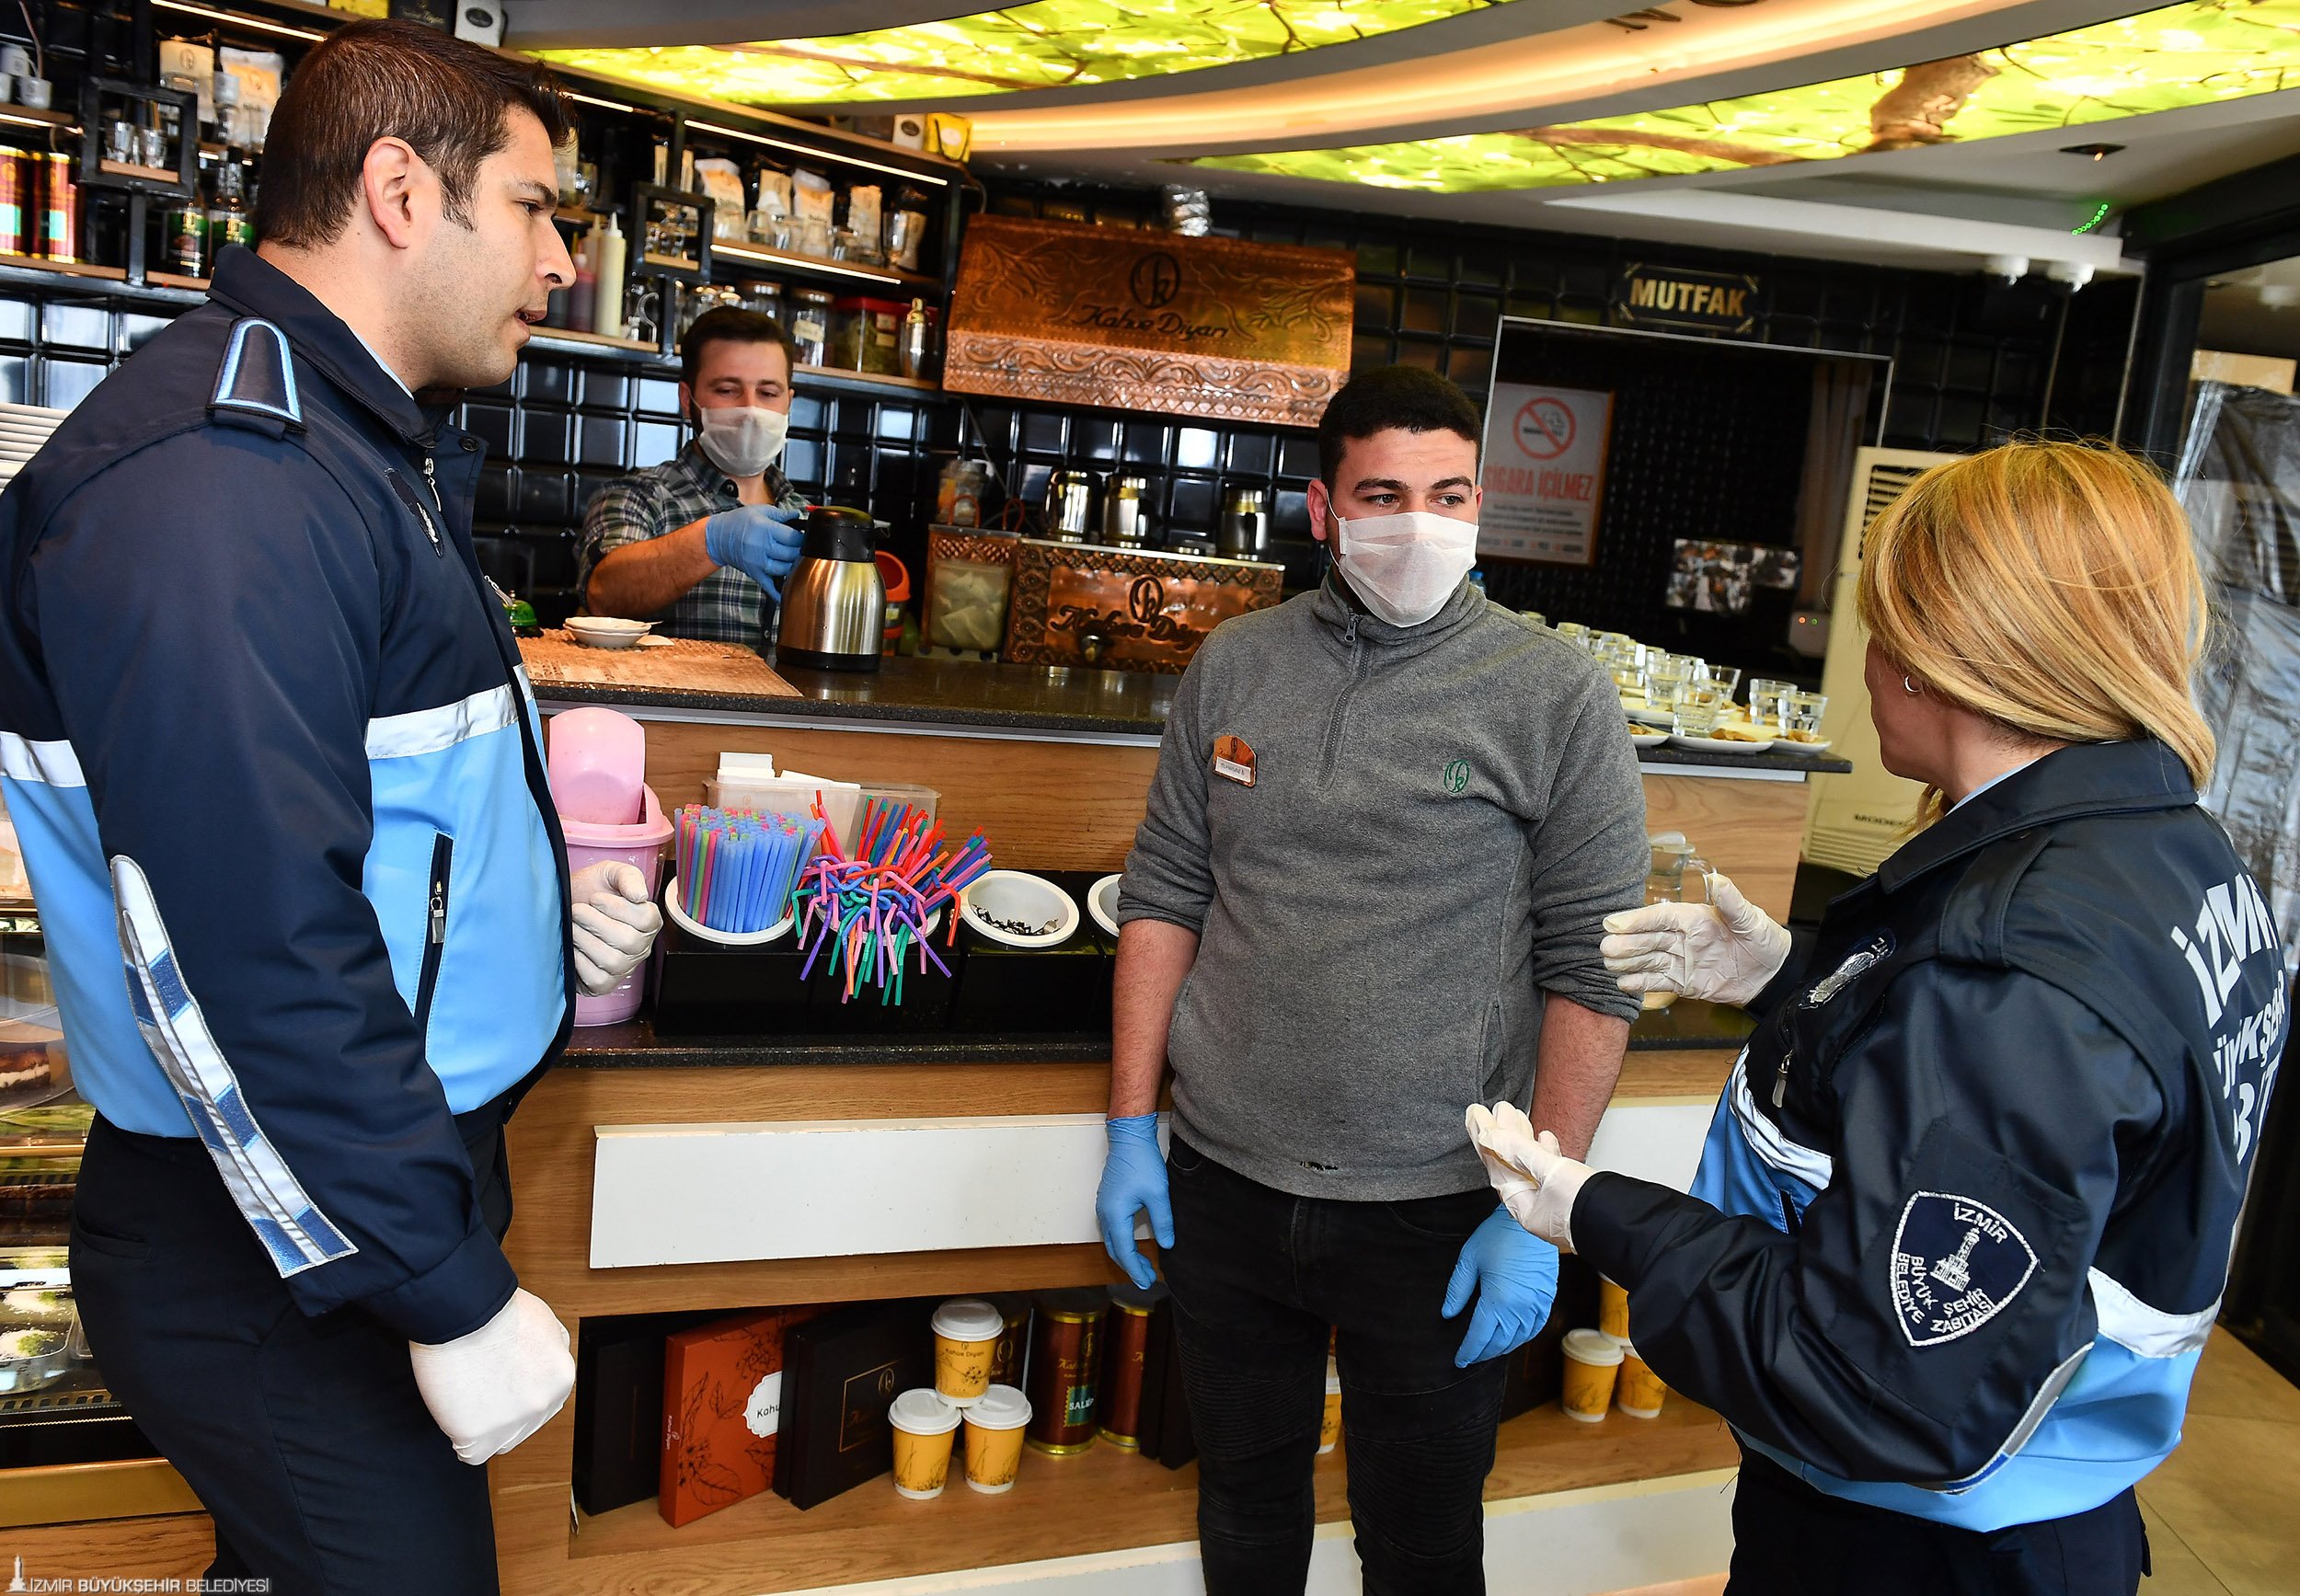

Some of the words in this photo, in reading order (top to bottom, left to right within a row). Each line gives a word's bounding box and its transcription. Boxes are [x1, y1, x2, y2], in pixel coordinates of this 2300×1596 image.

[1629, 278, 1747, 317] MUTFAK
[1072, 304, 1154, 331] Kahve
[1537, 465, 1593, 501] İÇİLMEZ
[1953, 1201, 2008, 1244] İZMİR
[1896, 1251, 1926, 1325] BELEDİYE
[1942, 1288, 1988, 1318] ŞEHİR
